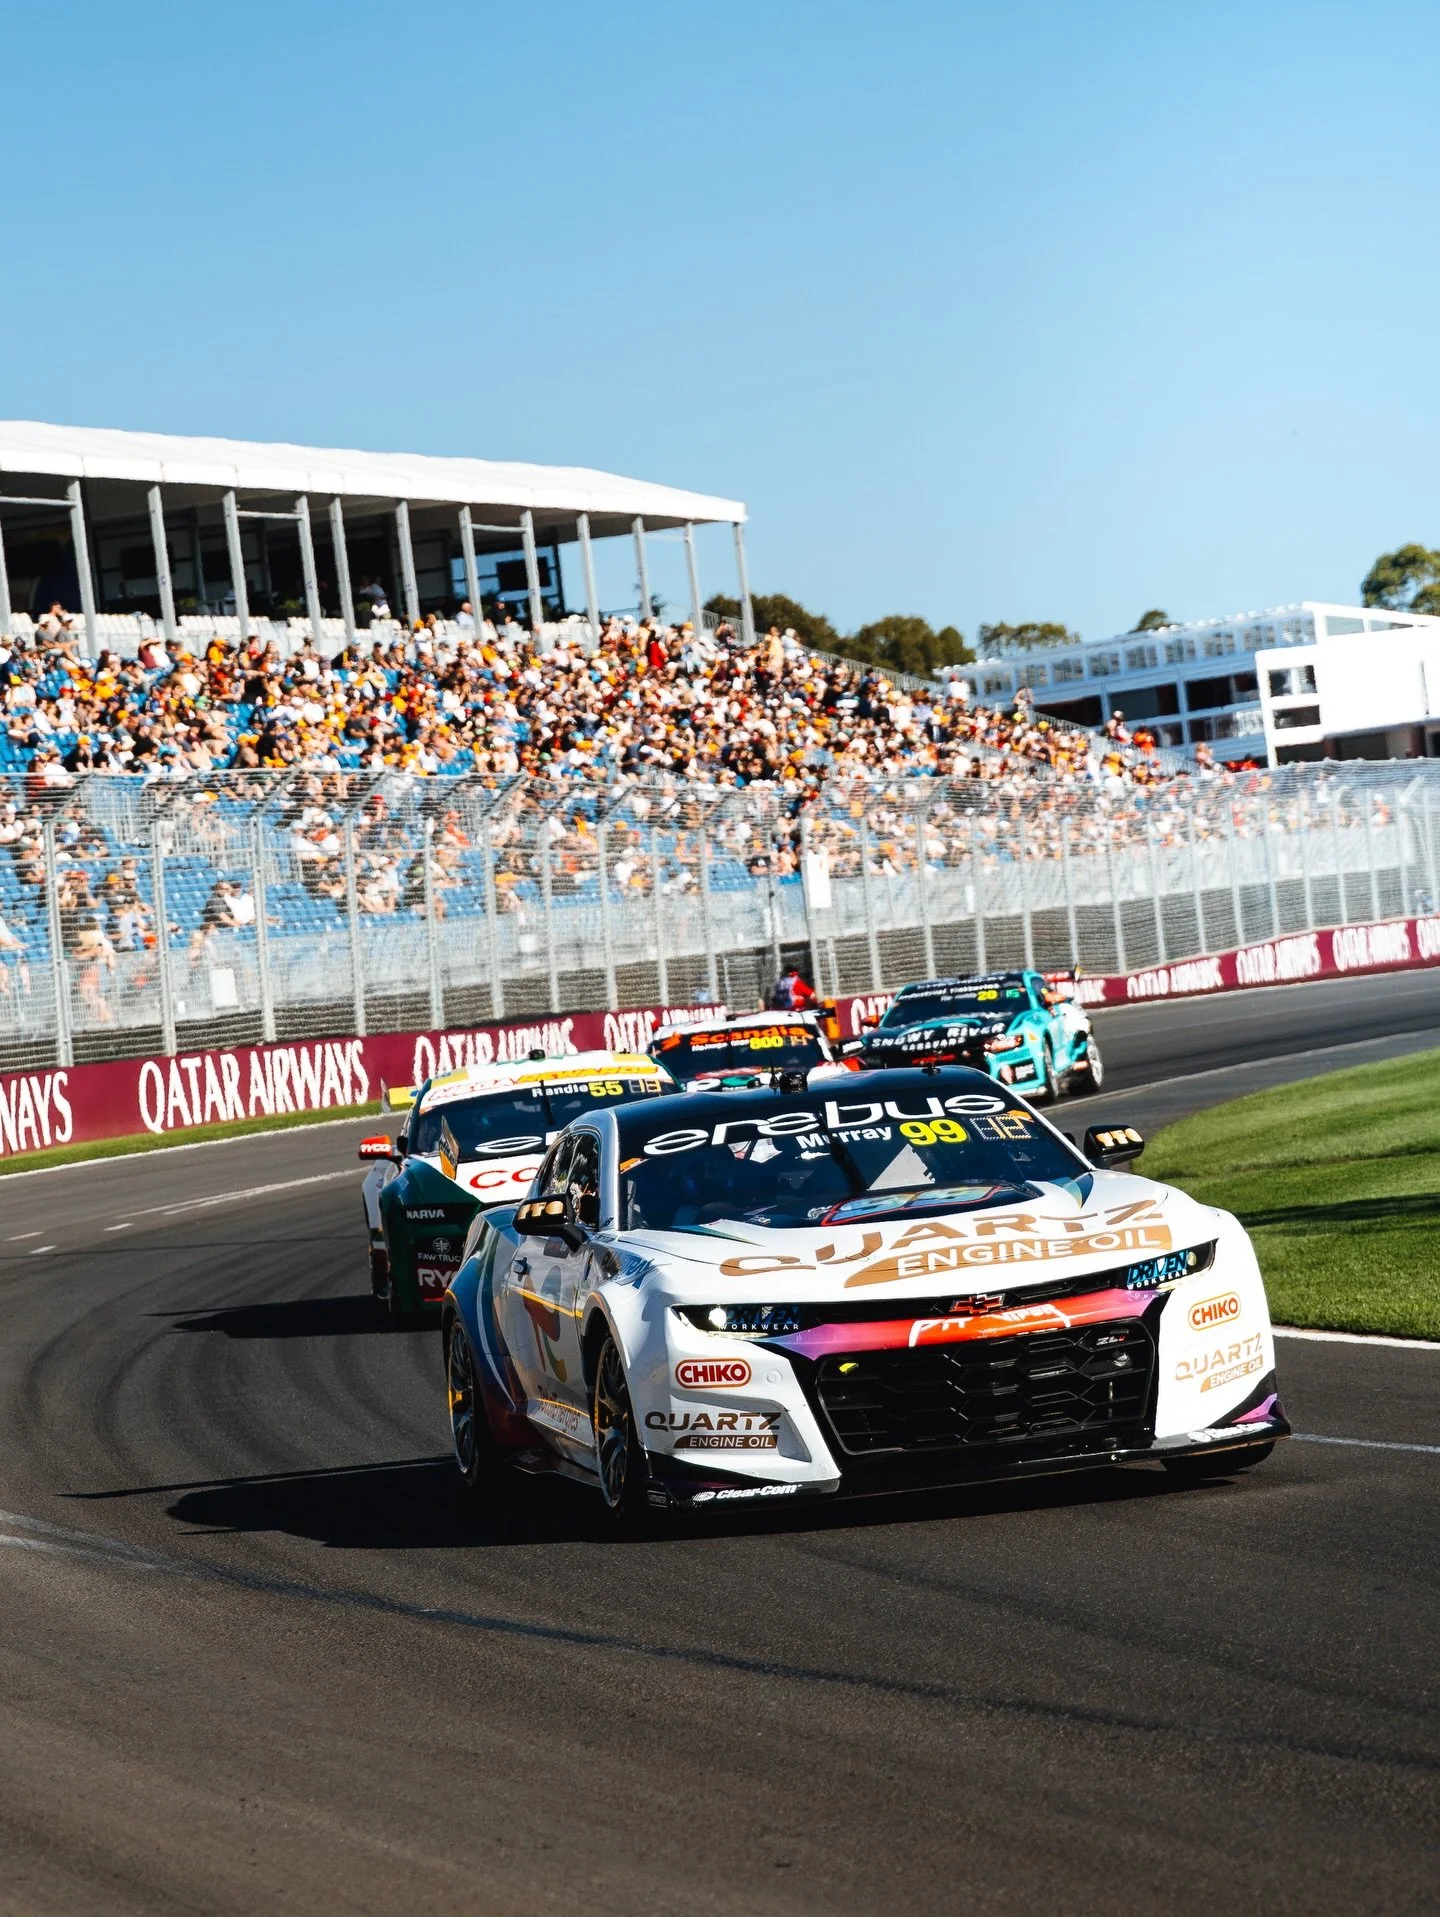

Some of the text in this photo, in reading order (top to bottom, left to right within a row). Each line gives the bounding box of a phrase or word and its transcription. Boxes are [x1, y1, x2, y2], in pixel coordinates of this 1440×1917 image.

[690, 1023, 811, 1045] Scandia
[872, 1030, 935, 1047] SNOWY
[947, 1023, 1007, 1038] RIVER
[138, 1039, 370, 1133] QATAR AIRWAYS
[531, 1083, 588, 1098] Randle
[588, 1079, 624, 1098] 55
[643, 1094, 1006, 1155] erebus
[900, 1119, 968, 1146] 99
[406, 1209, 445, 1219] NARVA
[719, 1199, 1165, 1277] QUARTZ
[417, 1252, 437, 1261] FAW
[898, 1227, 1162, 1278] ENGINE OIL
[1127, 1268, 1188, 1290] WORKWEAR
[1128, 1250, 1188, 1284] DRIVEN
[1192, 1297, 1239, 1326] CHIKO
[1175, 1332, 1263, 1381] QUARTZ
[680, 1363, 746, 1384] CHIKO
[1209, 1363, 1247, 1388] ENGINE
[645, 1411, 782, 1432] QUARTZ
[689, 1436, 773, 1447] ENGINE OIL
[716, 1484, 798, 1500] Clear-Com
